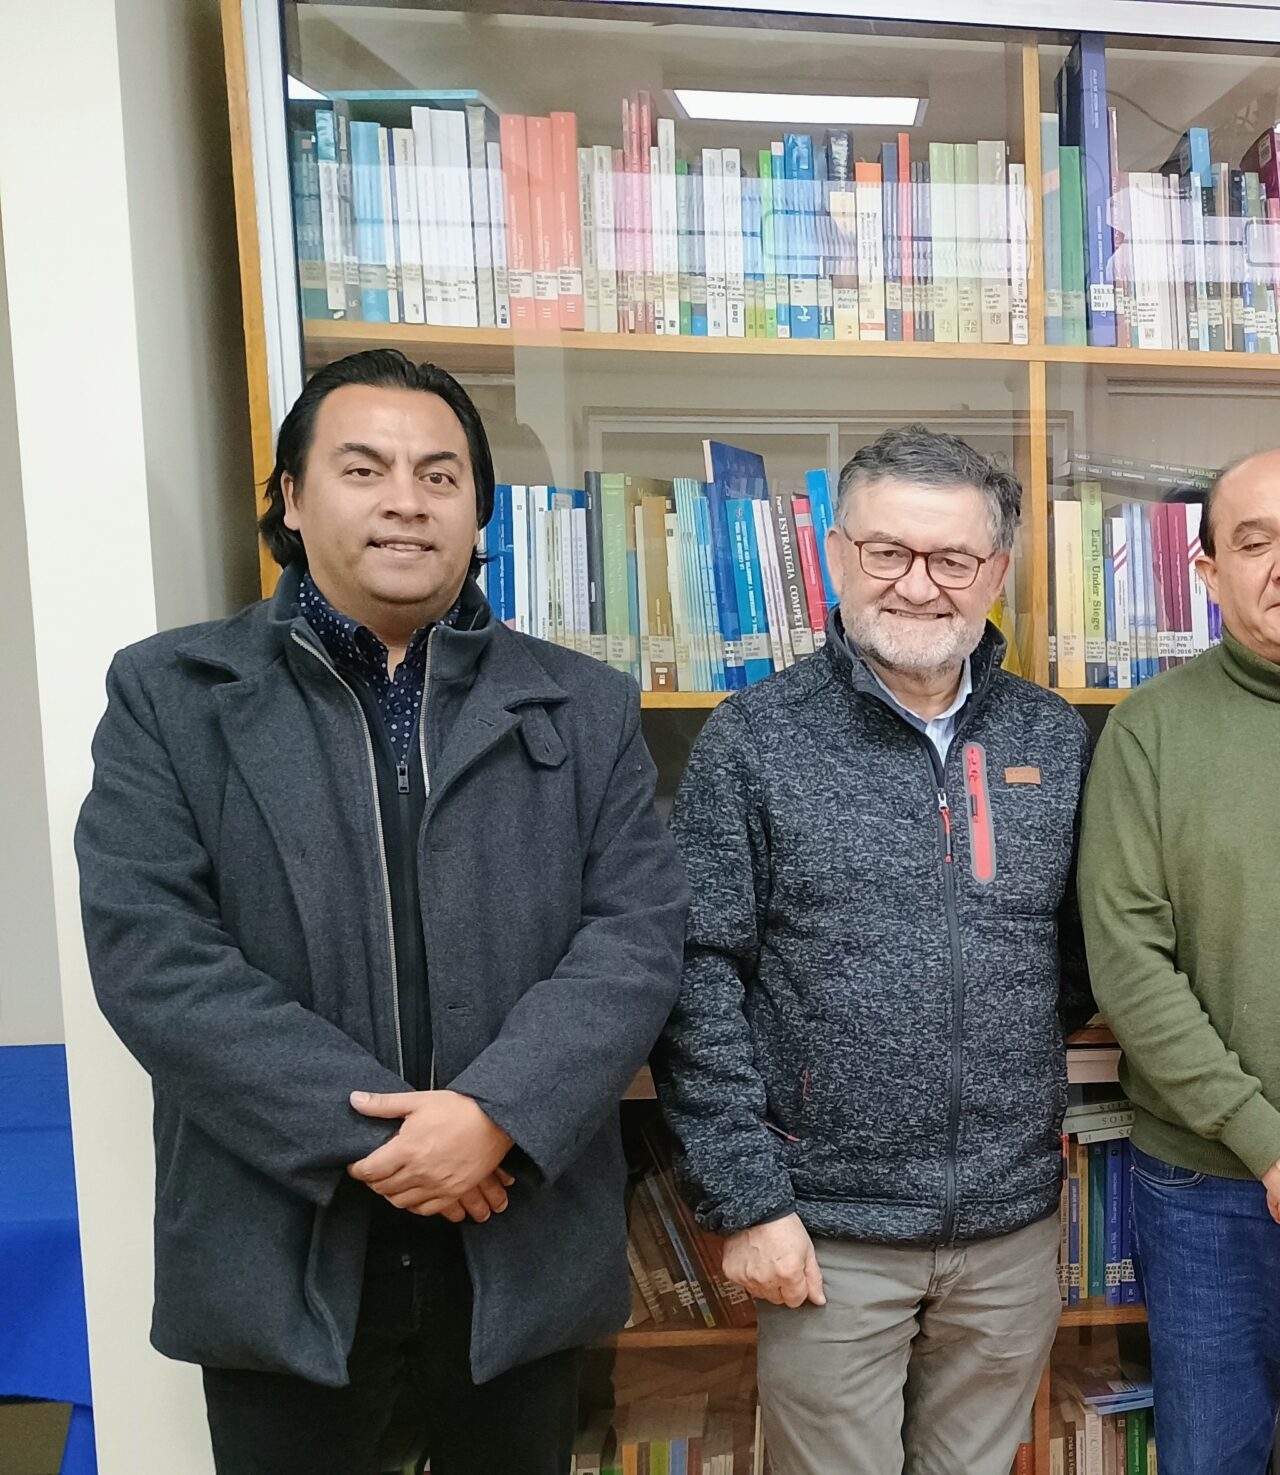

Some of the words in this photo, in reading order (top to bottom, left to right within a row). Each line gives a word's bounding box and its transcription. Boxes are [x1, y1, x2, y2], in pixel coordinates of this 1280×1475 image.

[1091, 529, 1100, 561] Earth
[778, 517, 794, 580] ESTRATEGIA
[789, 584, 803, 630] COMPET
[1092, 565, 1101, 597] Under
[1092, 600, 1102, 631] Siege
